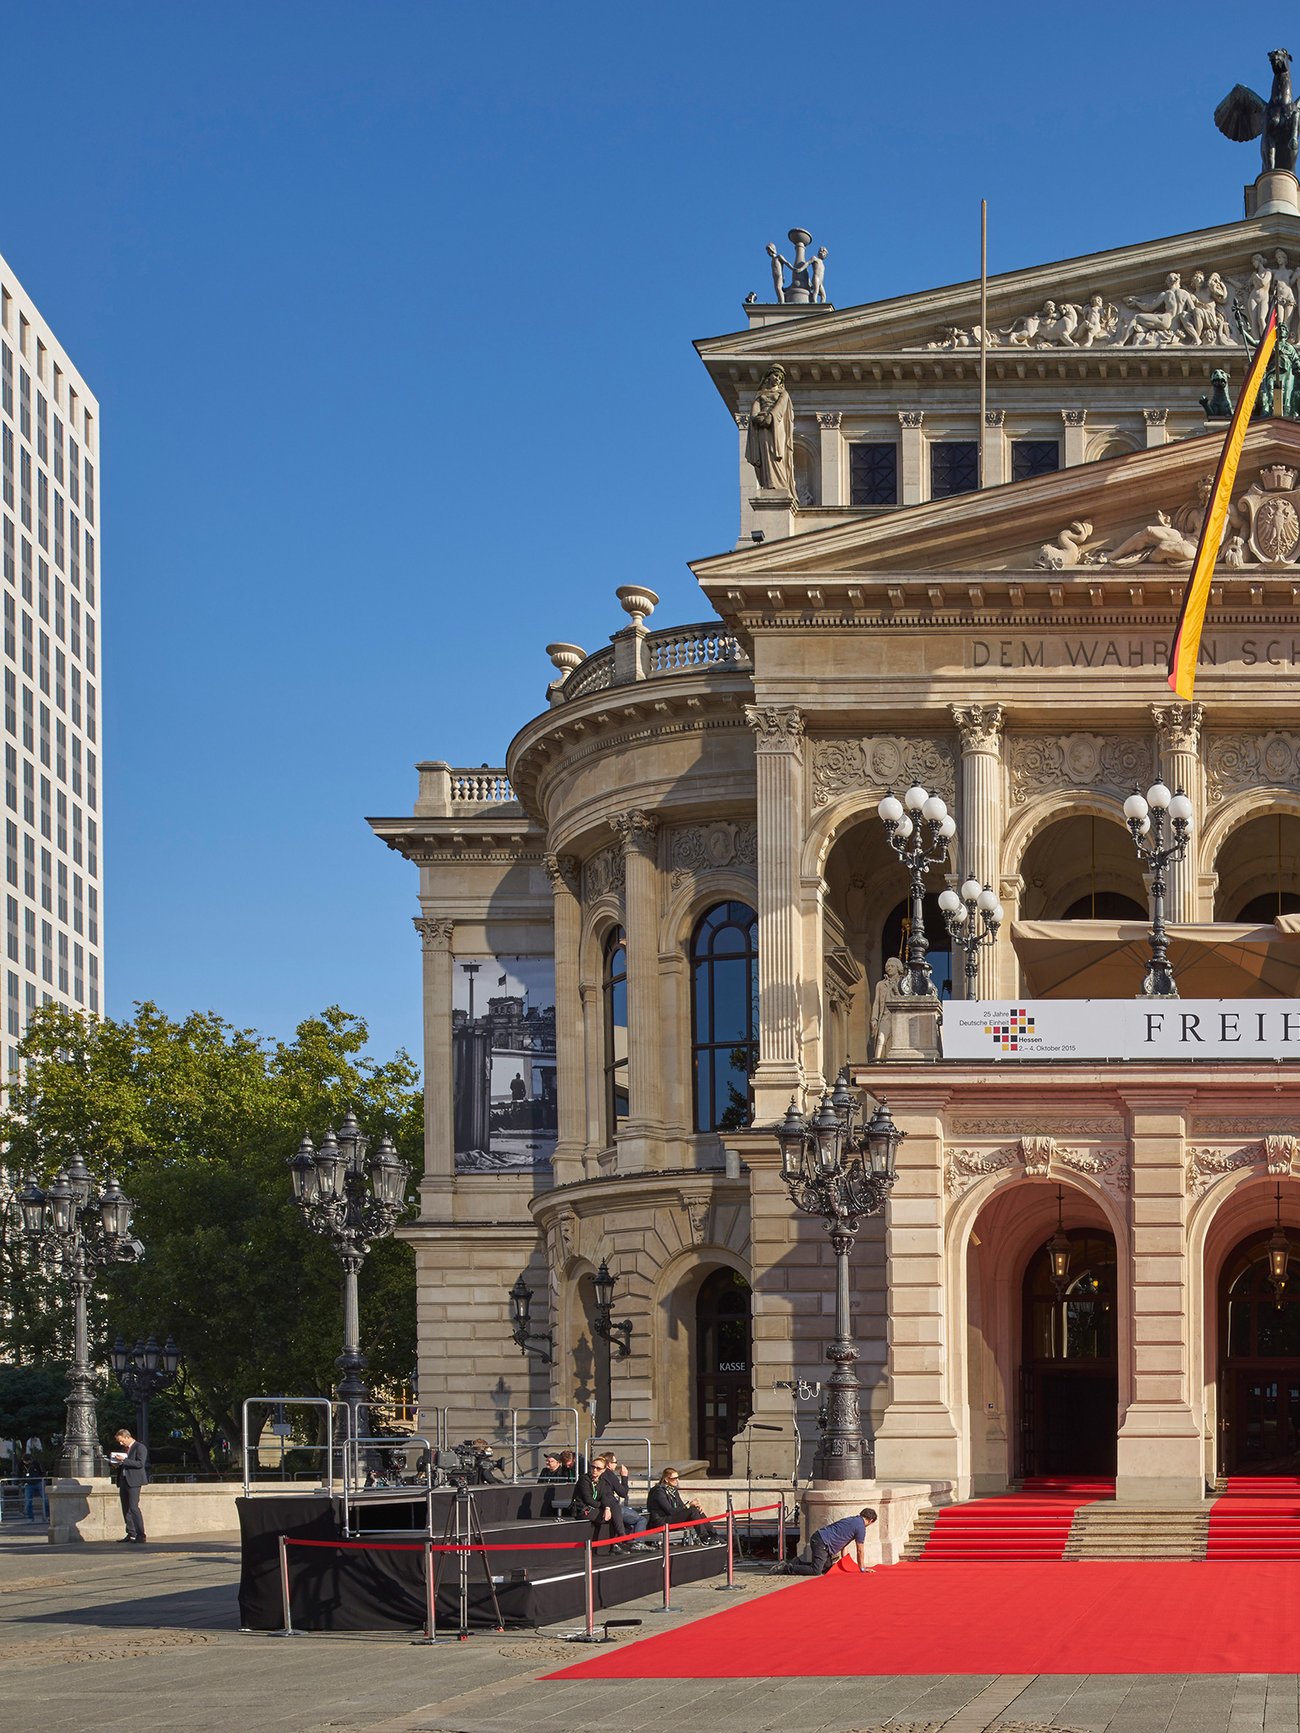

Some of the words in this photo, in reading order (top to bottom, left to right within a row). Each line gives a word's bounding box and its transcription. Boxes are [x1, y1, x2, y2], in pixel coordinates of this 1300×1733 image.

[973, 640, 1044, 667] DEM
[1065, 640, 1217, 667] WAHRN
[719, 1362, 746, 1371] KASSE
